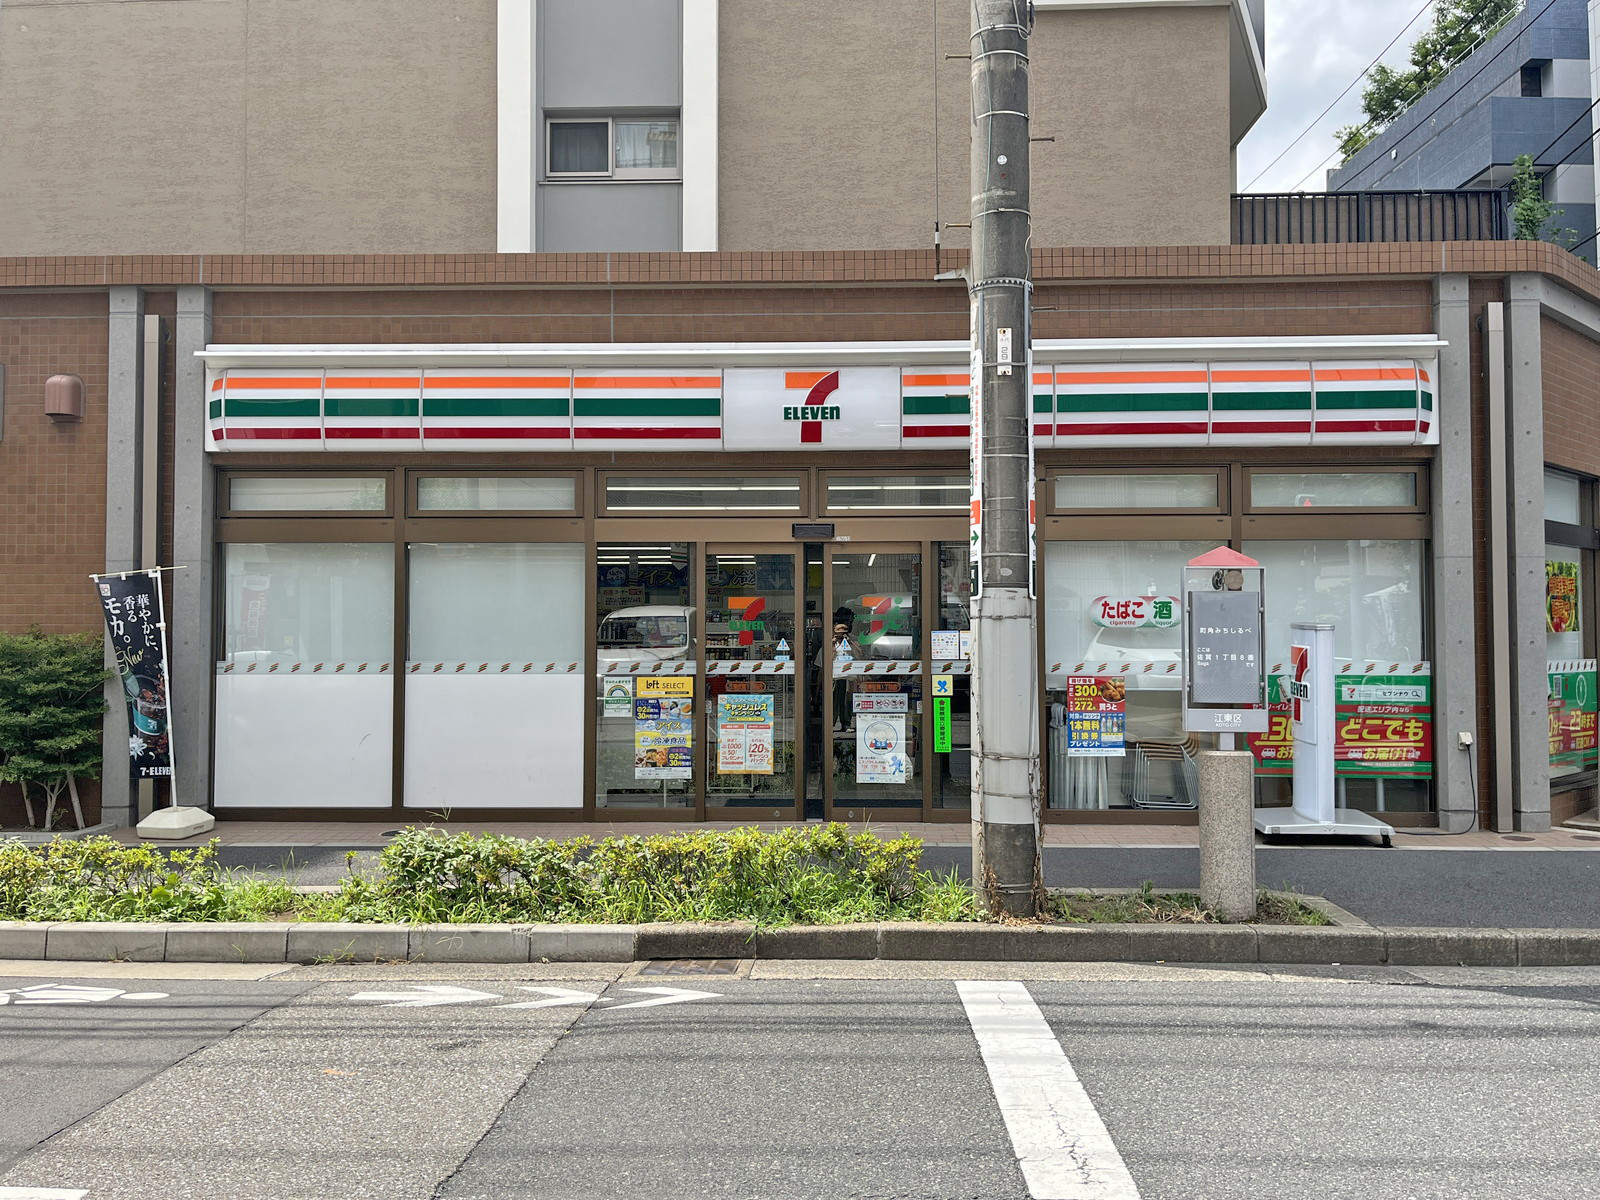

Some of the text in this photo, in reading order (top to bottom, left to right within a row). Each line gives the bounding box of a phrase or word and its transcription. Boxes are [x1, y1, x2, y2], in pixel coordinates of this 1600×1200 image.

[123, 595, 138, 623] 香る
[1101, 600, 1172, 619] たばこ 酒
[104, 597, 132, 644] モカ。
[136, 593, 159, 652] 華やかに、
[646, 680, 660, 690] Loft
[724, 703, 768, 711] キャッシュレス
[1098, 703, 1118, 711] 買うと
[1214, 713, 1242, 723] 江東区
[655, 721, 683, 730] アイス
[1069, 720, 1100, 731] 1本無料
[1340, 718, 1424, 741] どこでも
[654, 736, 688, 746] 冷凍食品
[1363, 747, 1407, 760] お届け!
